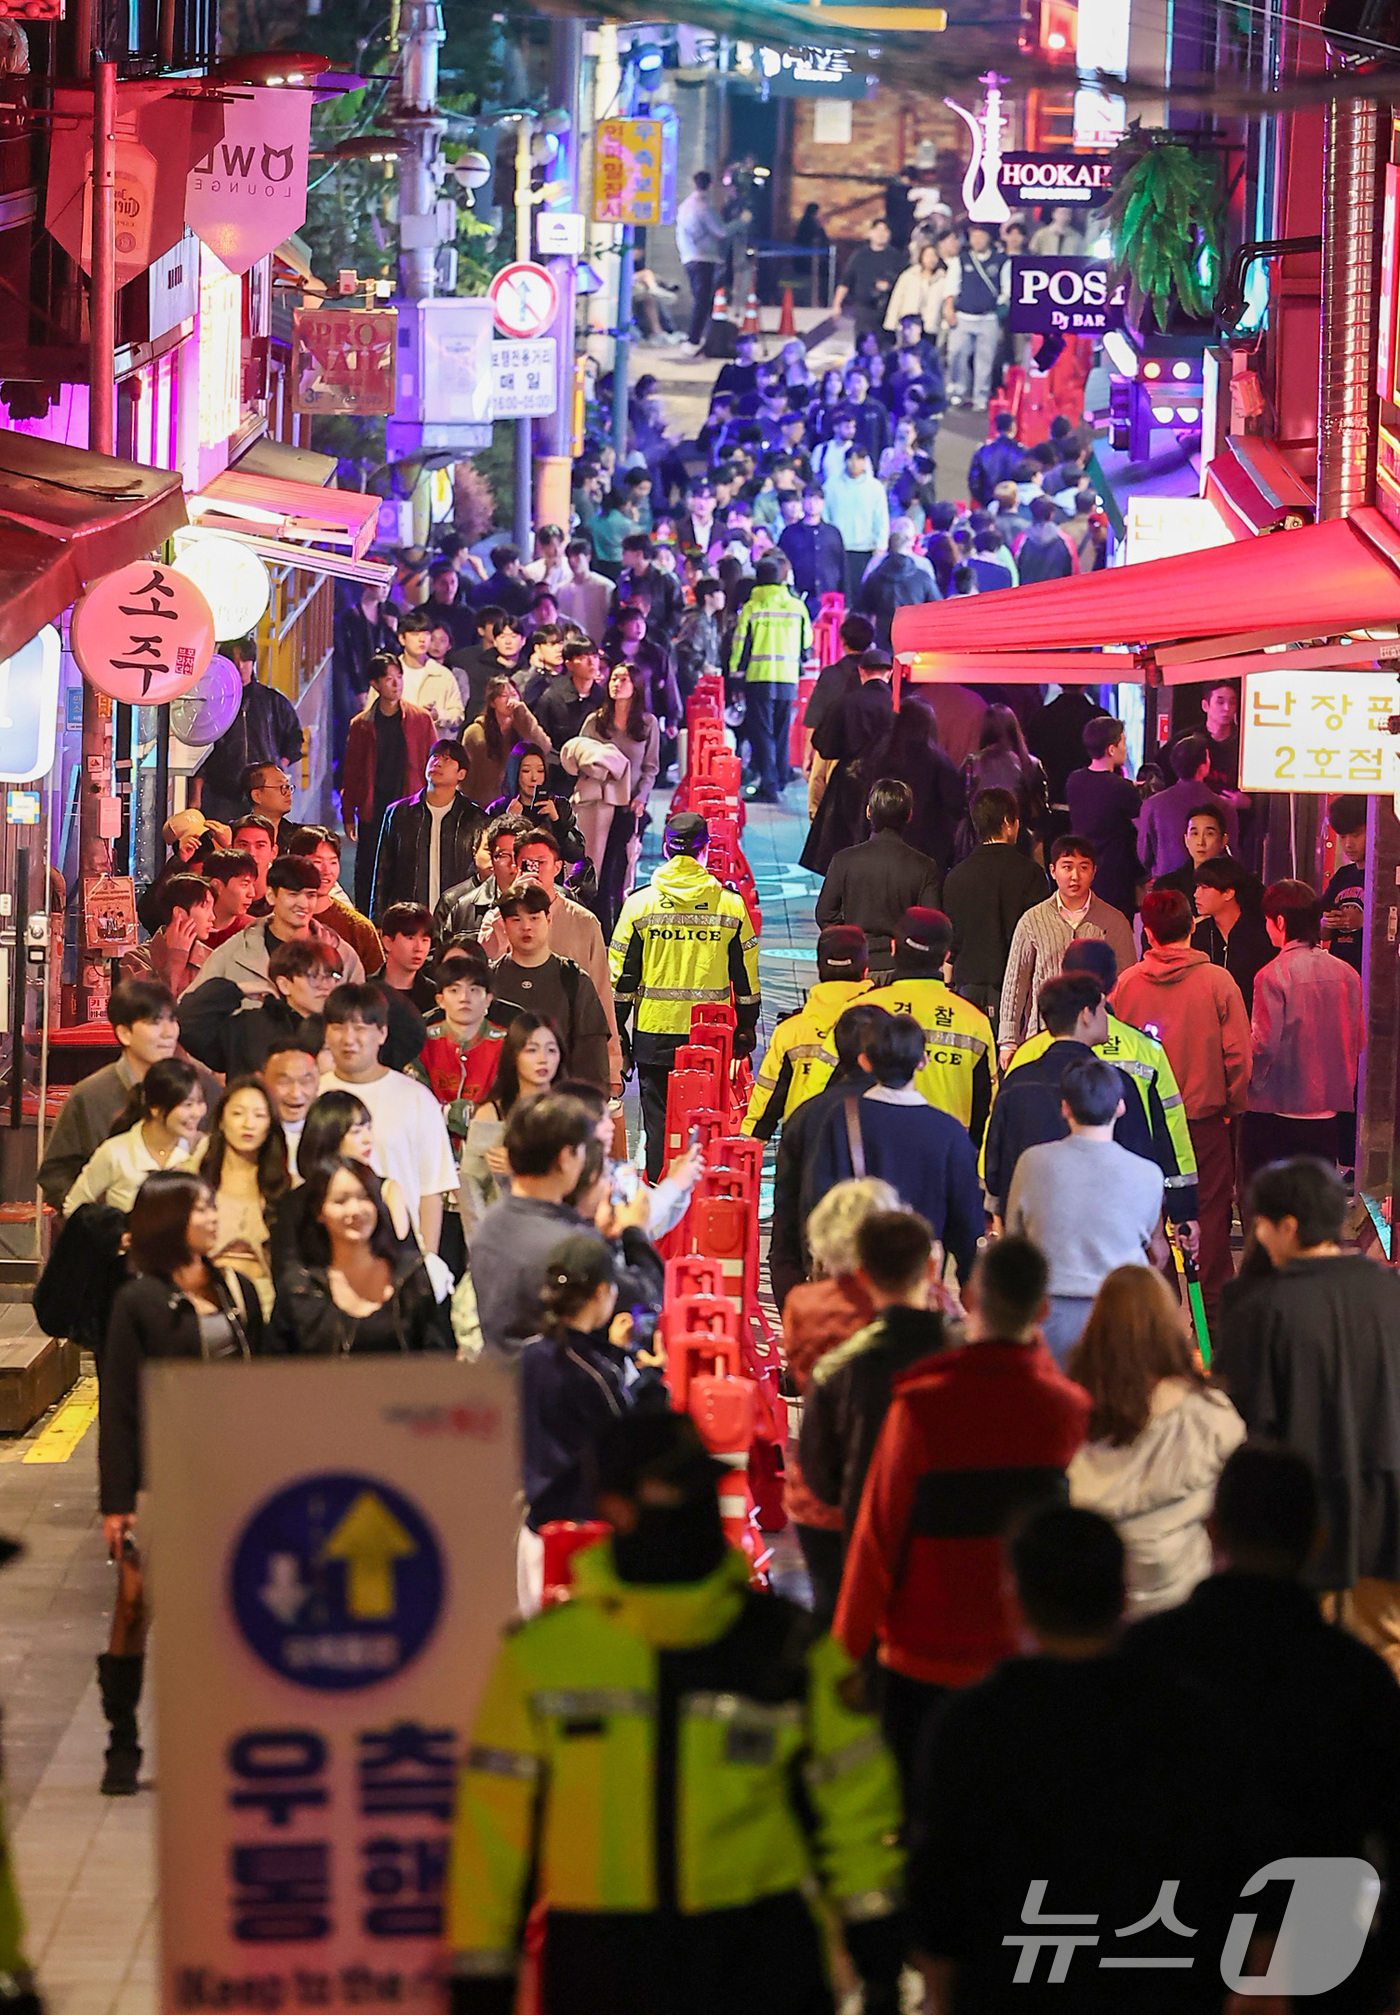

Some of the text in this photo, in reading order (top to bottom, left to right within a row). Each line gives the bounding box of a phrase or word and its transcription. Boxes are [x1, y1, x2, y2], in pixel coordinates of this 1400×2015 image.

[1072, 314, 1107, 327] BAR
[109, 569, 180, 698] 소주
[1274, 746, 1383, 780] 2호점
[649, 928, 722, 942] POLICE
